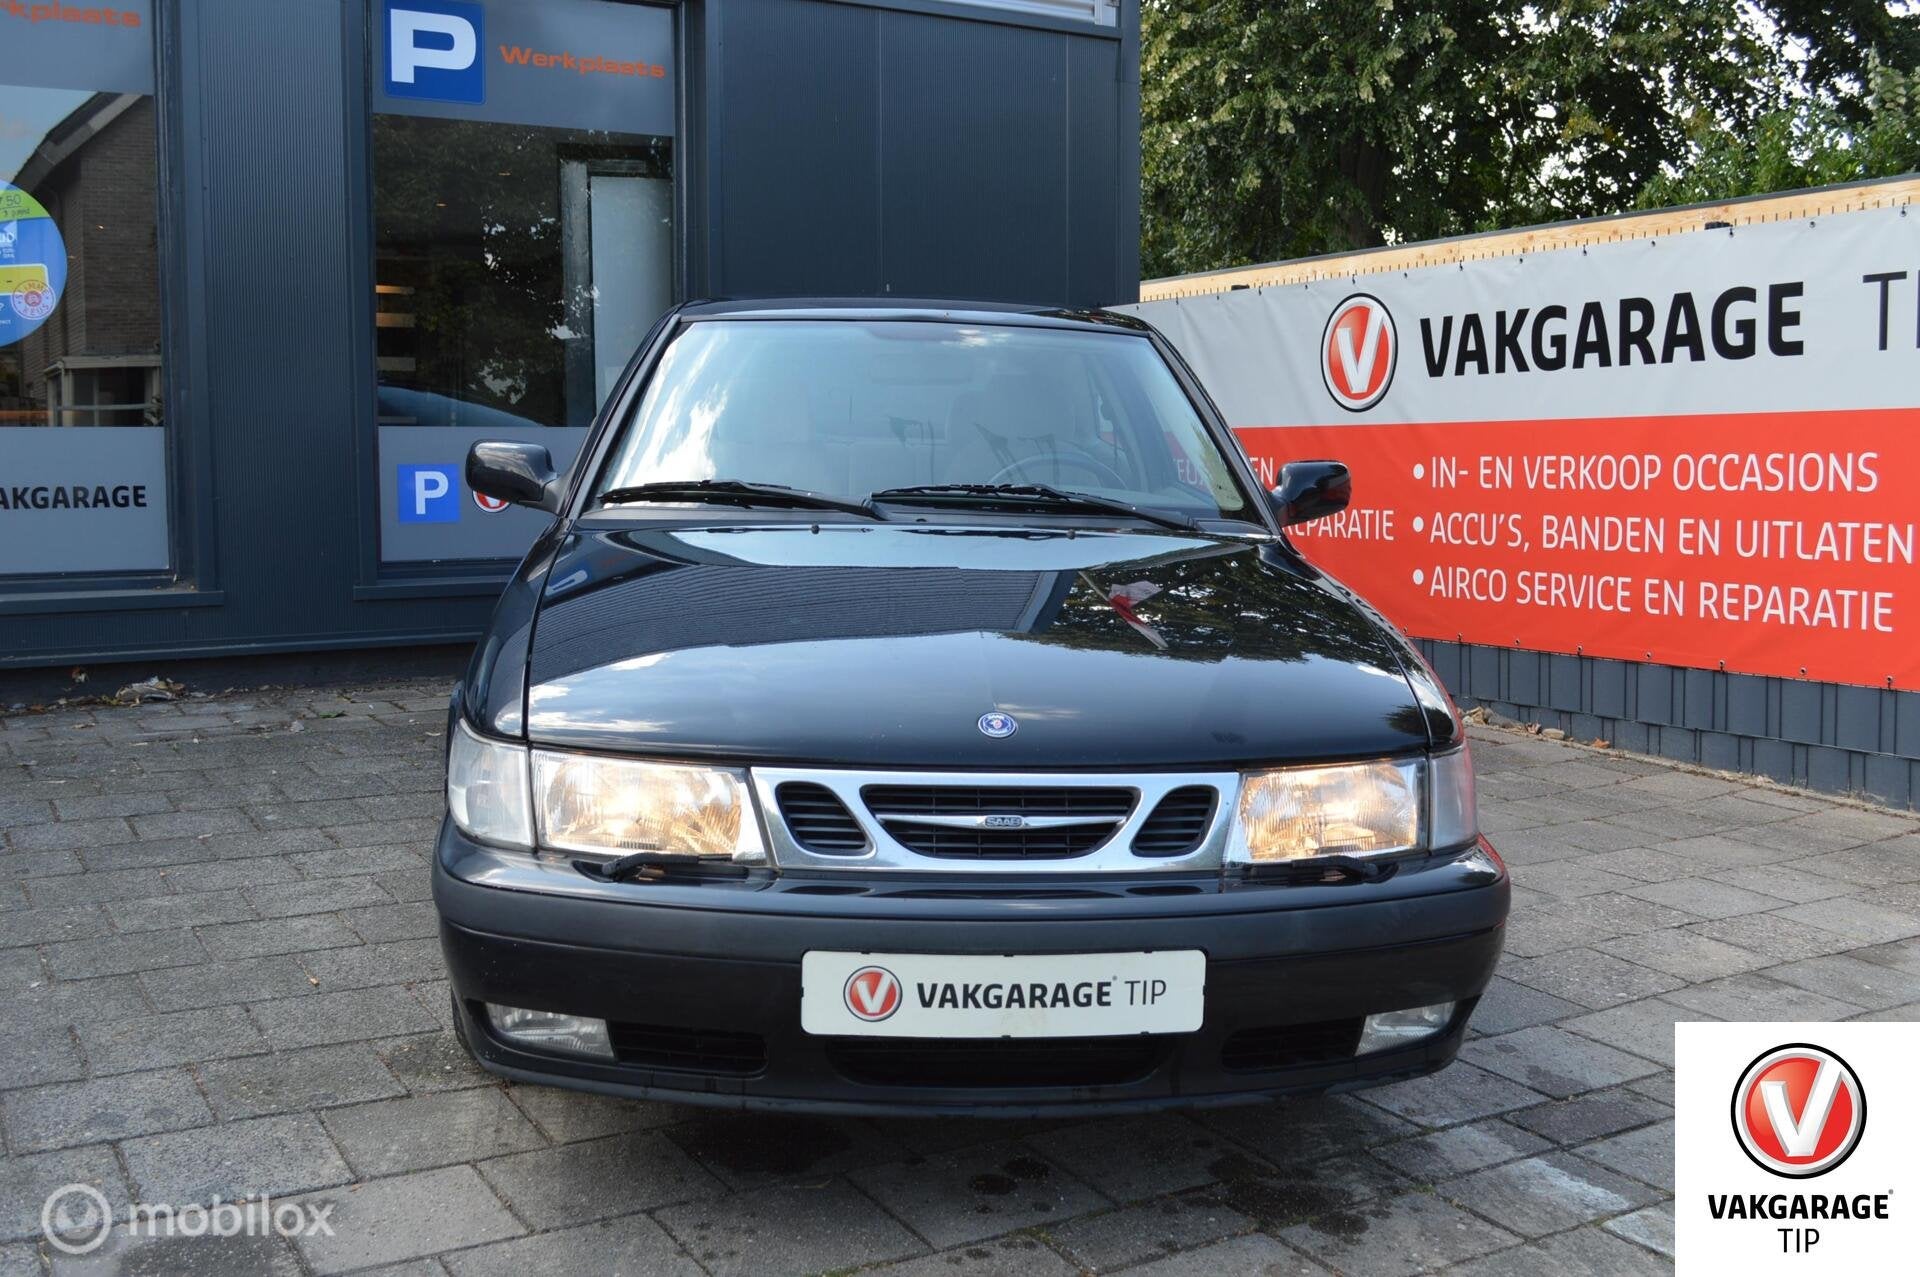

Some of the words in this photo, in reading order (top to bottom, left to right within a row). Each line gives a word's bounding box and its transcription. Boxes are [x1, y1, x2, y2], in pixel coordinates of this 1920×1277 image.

[390, 8, 477, 84] P
[499, 45, 666, 79] Werkplaats
[1419, 281, 1804, 378] VAKGARAGE
[414, 470, 449, 515] P
[1431, 455, 1469, 489] IN-
[1479, 455, 1513, 489] EN
[1522, 454, 1662, 491] VERKOOP
[1672, 452, 1878, 493] OCCASIONS
[1282, 508, 1395, 541] PARATIE
[1429, 511, 1531, 553] ACCU'S,
[1541, 514, 1665, 554] BANDEN
[1678, 518, 1720, 557] EN
[1735, 519, 1914, 565] UITLATEN
[1429, 565, 1507, 603] AIRCO
[1515, 570, 1633, 613] SERVICE
[1643, 578, 1685, 618] EN
[1699, 581, 1894, 633] REPARATIE
[916, 981, 1113, 1010] VAKGARAGE
[1124, 979, 1167, 1006] TIP
